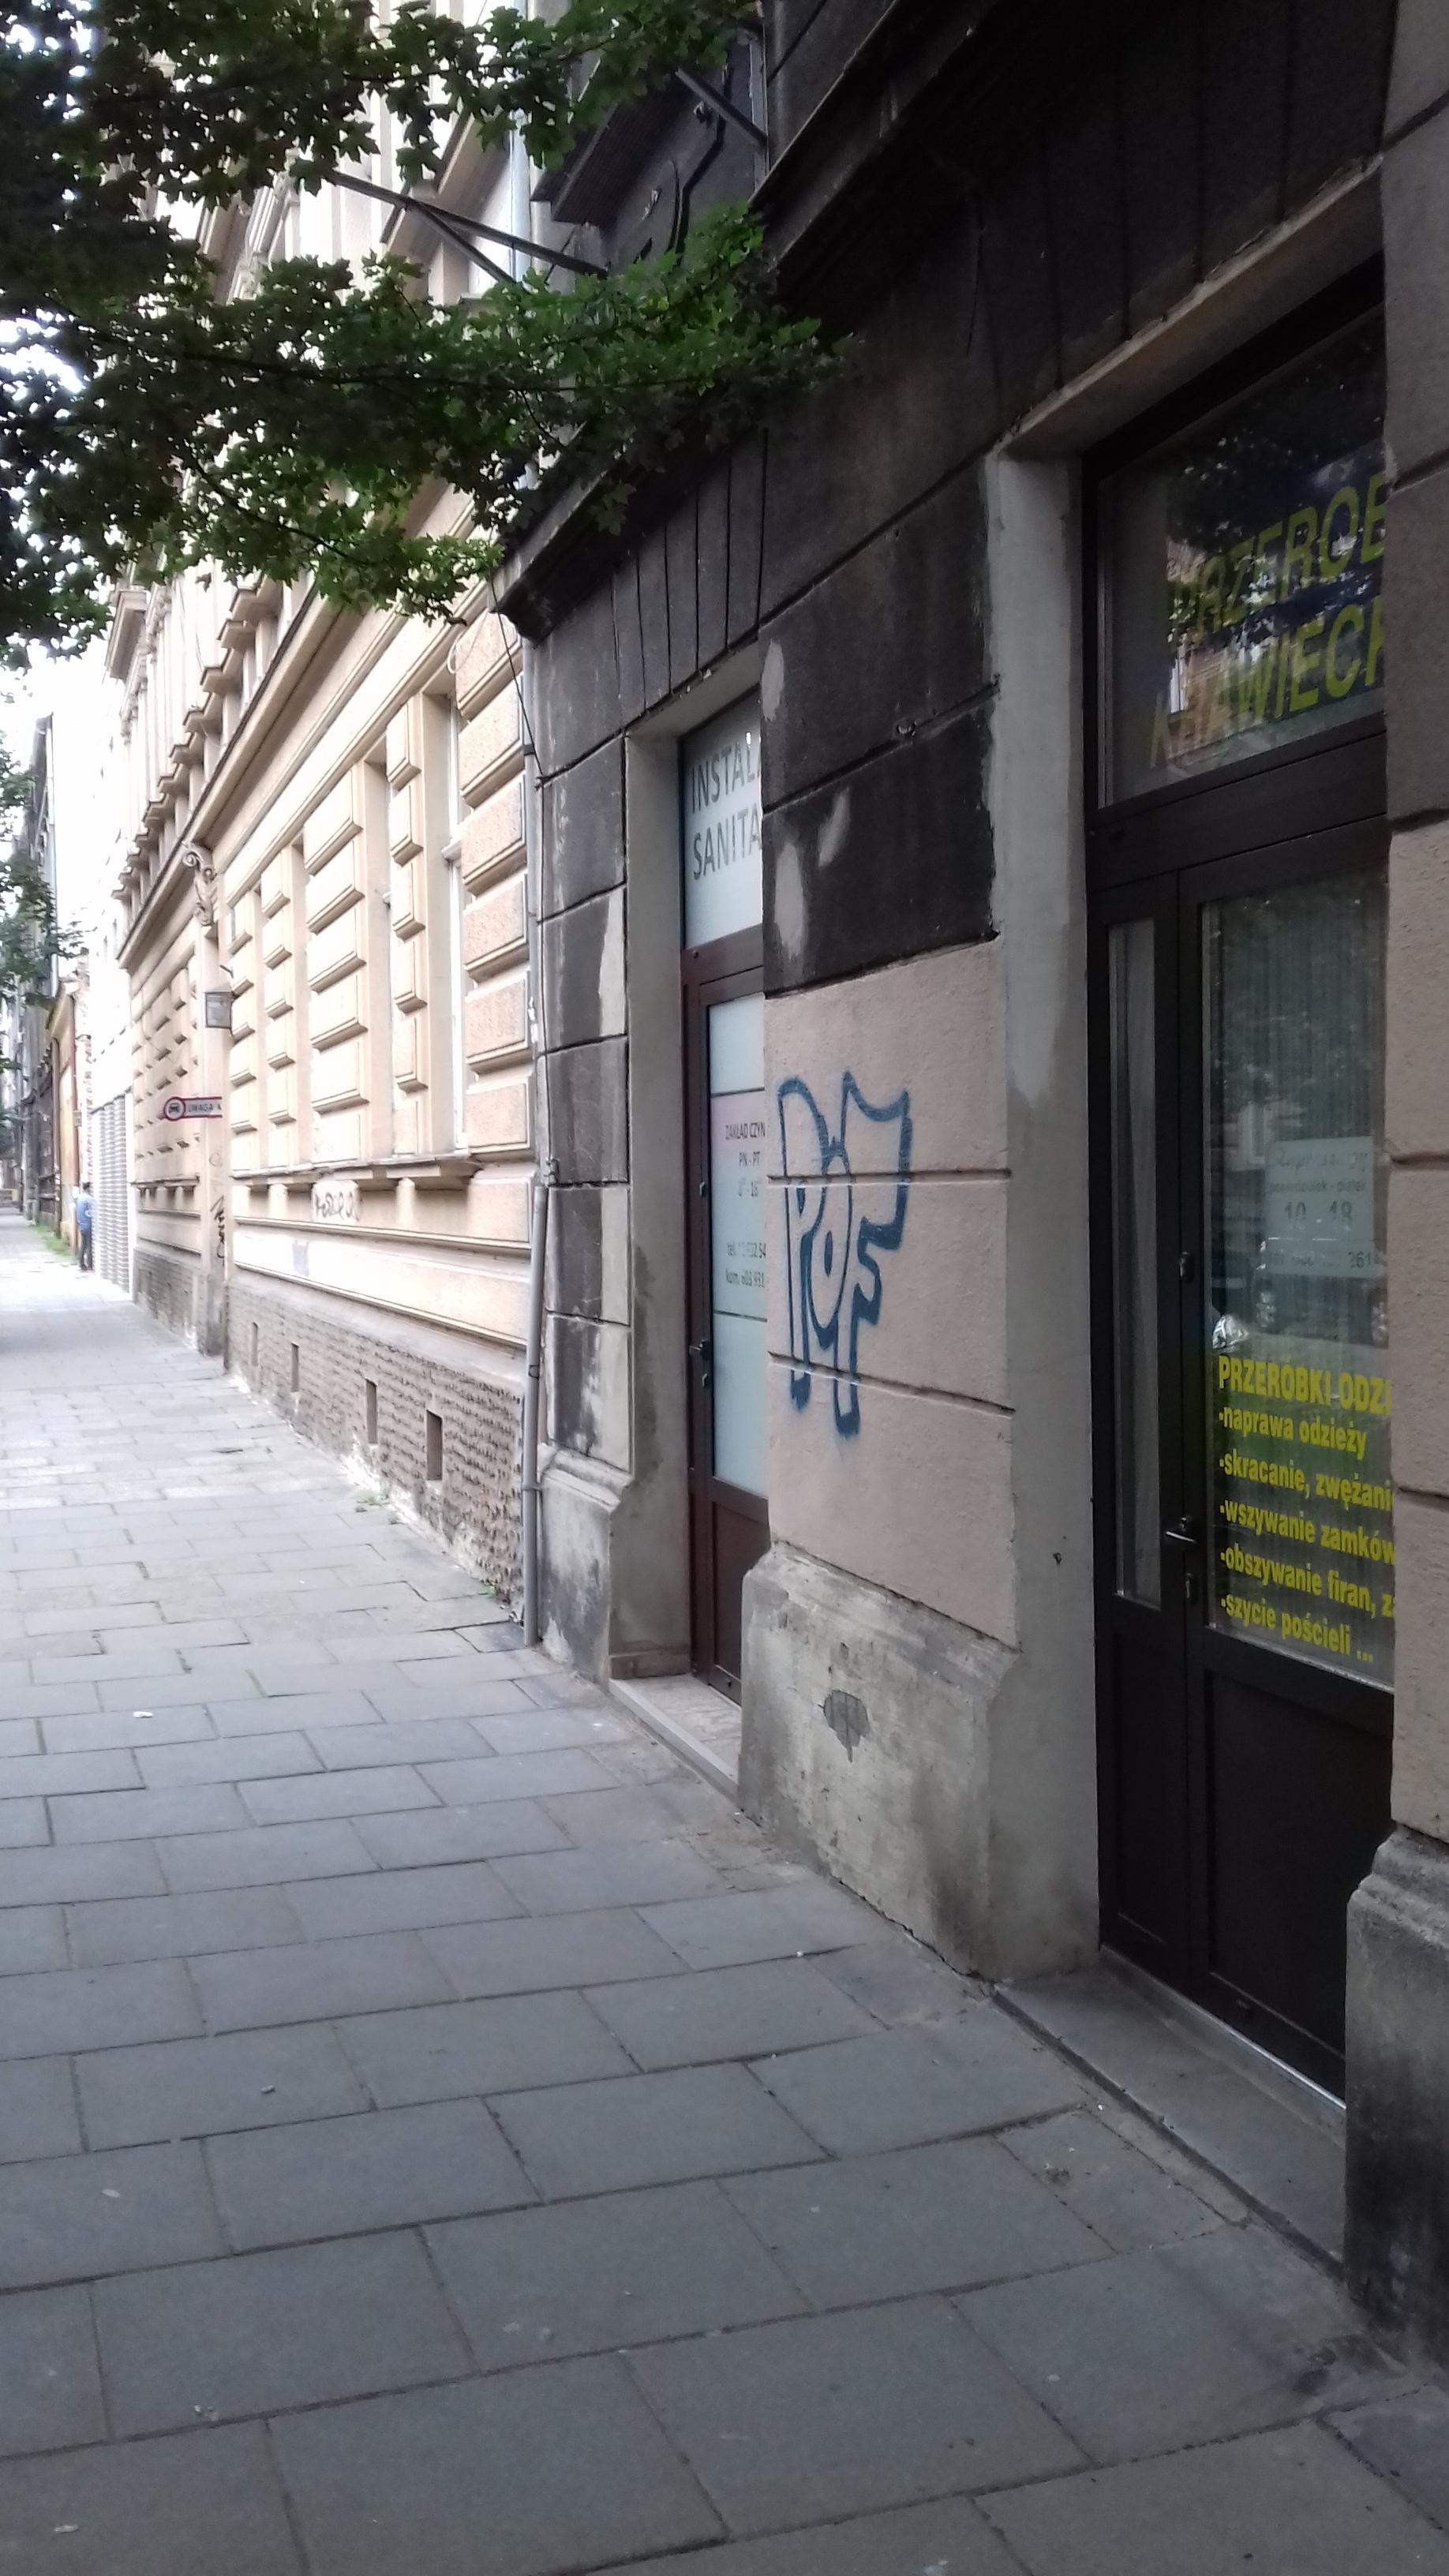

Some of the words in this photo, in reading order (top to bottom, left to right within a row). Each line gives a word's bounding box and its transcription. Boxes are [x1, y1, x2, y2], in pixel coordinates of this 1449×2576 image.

[692, 741, 762, 814] INSTAL
[1299, 1415, 1367, 1460] odzieży
[1315, 1473, 1394, 1511] zwężani
[1327, 1571, 1376, 1619] firan,
[1281, 1612, 1351, 1656] pościeli
